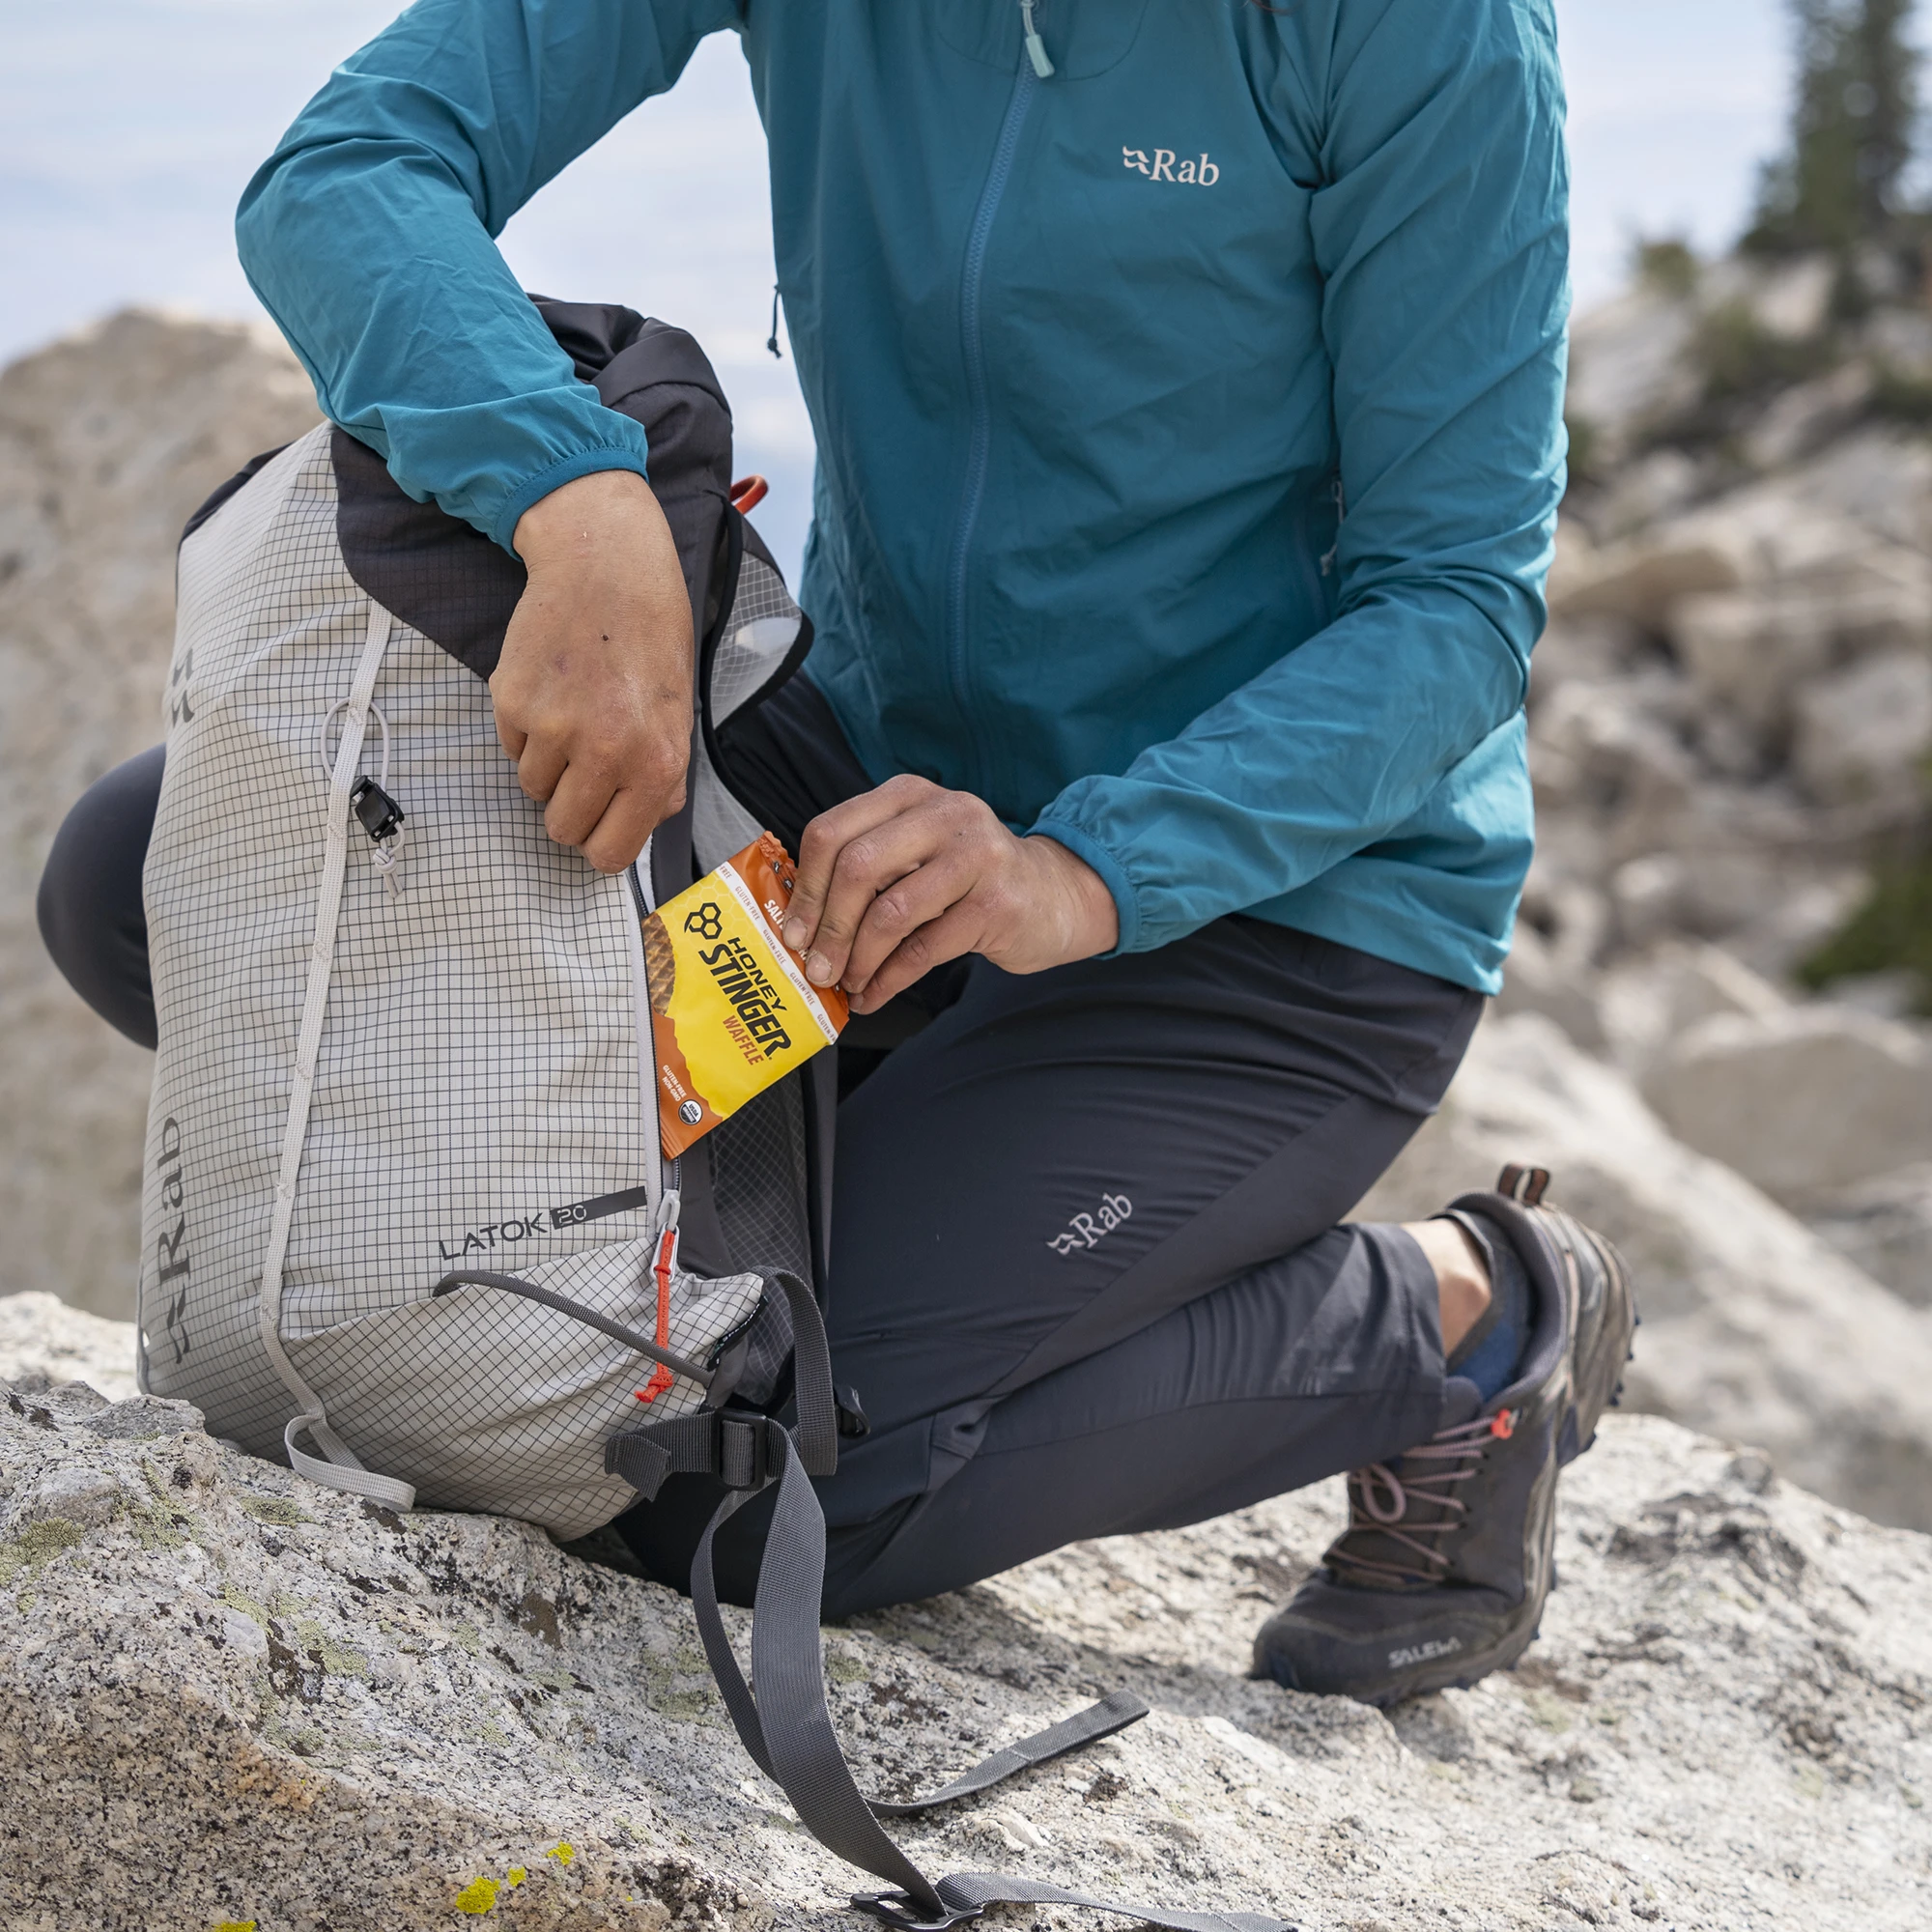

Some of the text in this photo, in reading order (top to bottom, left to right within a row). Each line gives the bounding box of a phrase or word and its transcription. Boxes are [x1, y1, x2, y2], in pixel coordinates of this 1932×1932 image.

[1149, 148, 1220, 186] Rab
[734, 886, 761, 922] GLUTEN-FREE
[763, 899, 784, 930] SALT
[762, 929, 787, 965] GLUTEN-FREE
[727, 937, 787, 1011] HONEY
[789, 972, 815, 1007] GLUTEN-FREE
[697, 943, 792, 1058] STINGER
[722, 1014, 764, 1065] WAFFLE
[157, 1117, 191, 1292] Rab
[1067, 1192, 1133, 1249] Rab
[440, 1205, 587, 1261] LATOK 20
